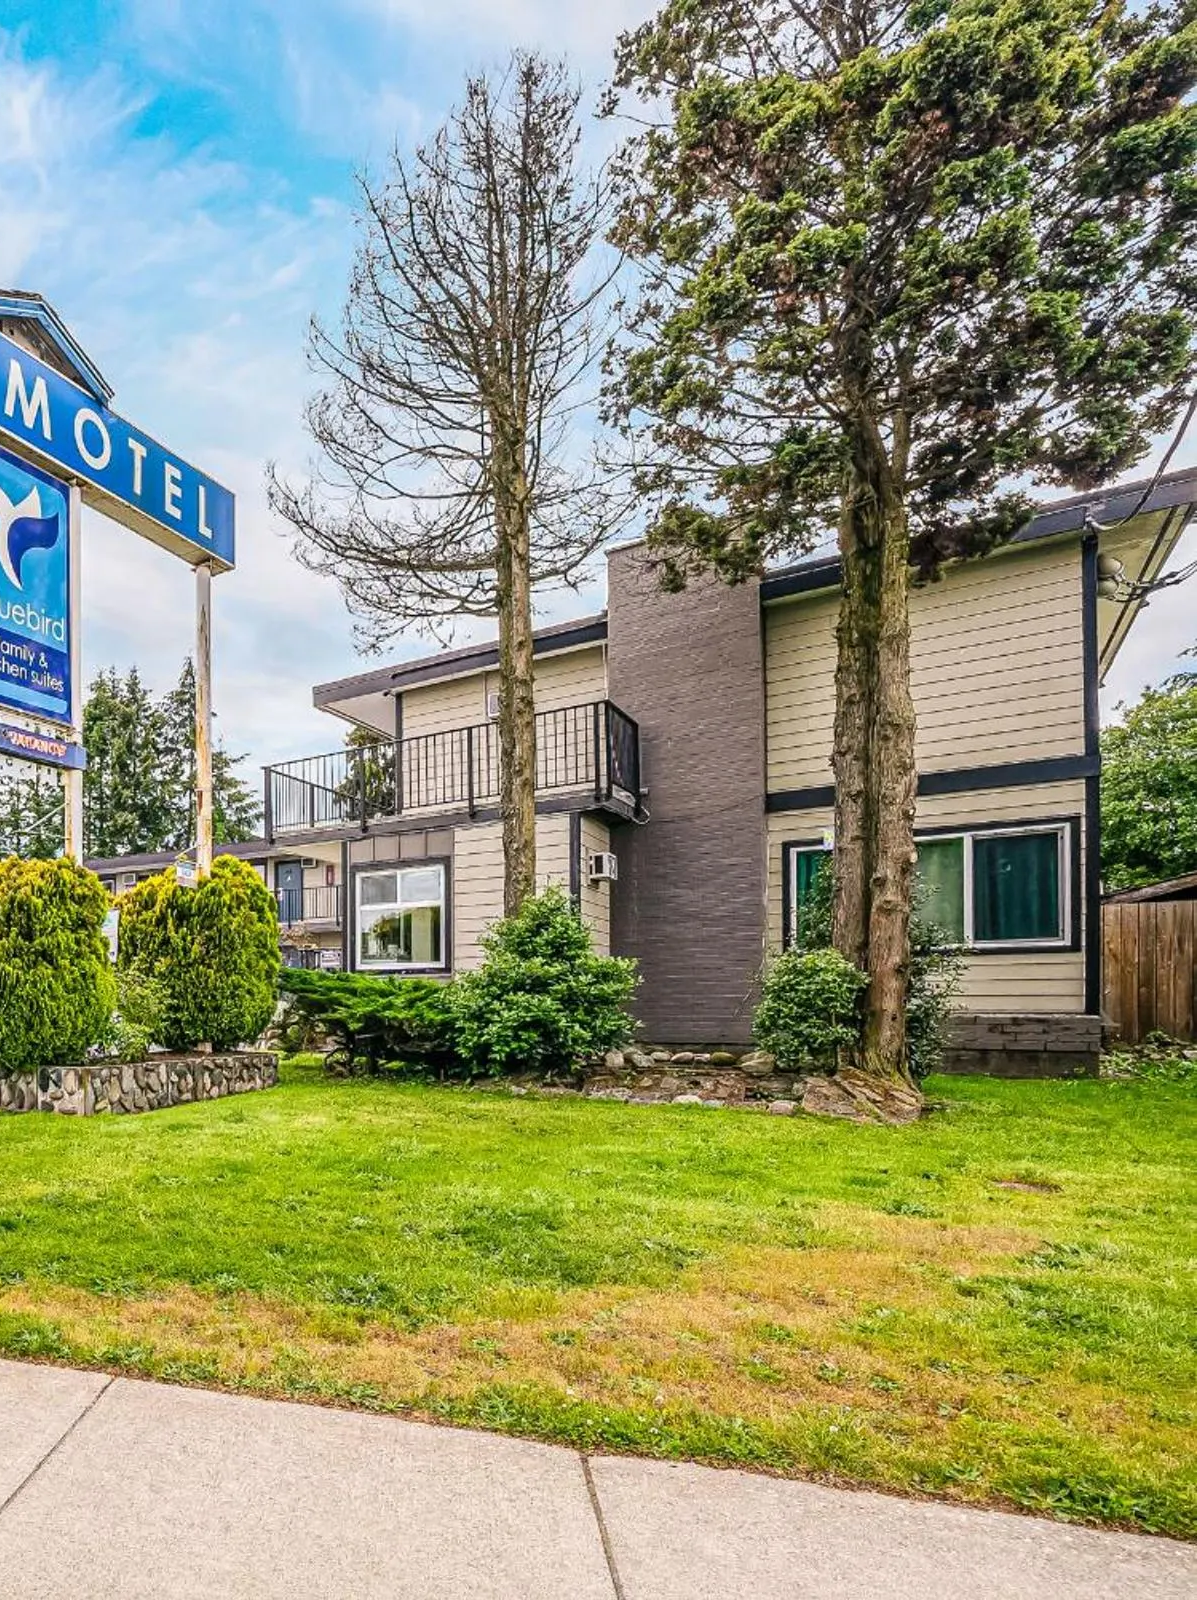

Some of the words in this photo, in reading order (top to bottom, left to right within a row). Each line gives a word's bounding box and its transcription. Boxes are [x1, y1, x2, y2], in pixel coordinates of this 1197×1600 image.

[3, 358, 213, 540] MOTEL
[39, 652, 48, 669] &
[30, 670, 65, 693] suites
